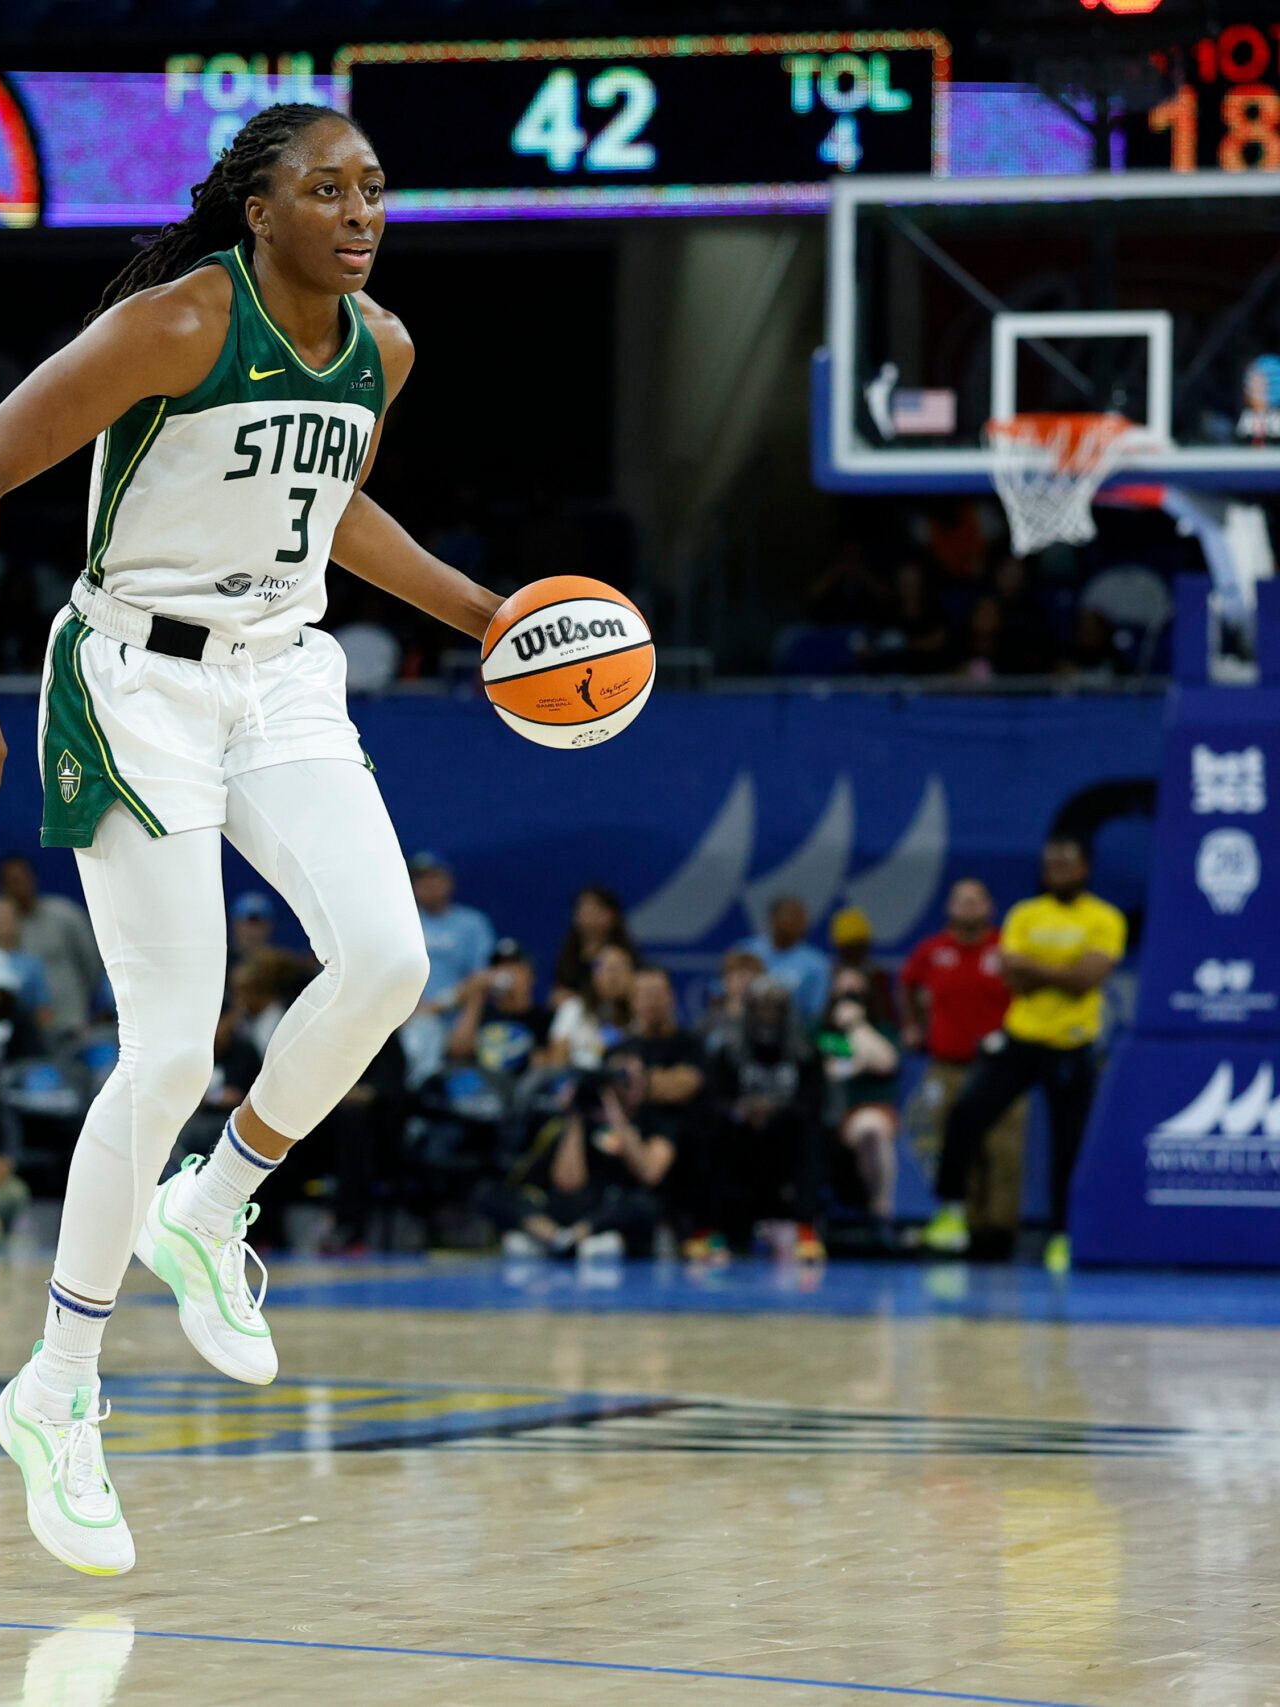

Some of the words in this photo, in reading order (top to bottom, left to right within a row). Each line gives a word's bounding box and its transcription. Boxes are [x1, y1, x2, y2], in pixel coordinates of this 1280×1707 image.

[165, 52, 331, 112] FOUL
[782, 53, 911, 114] TOL
[511, 67, 658, 173] 42
[817, 112, 863, 172] 4
[224, 413, 368, 483] STORM
[275, 487, 318, 563] 3
[511, 615, 627, 662] Wilson
